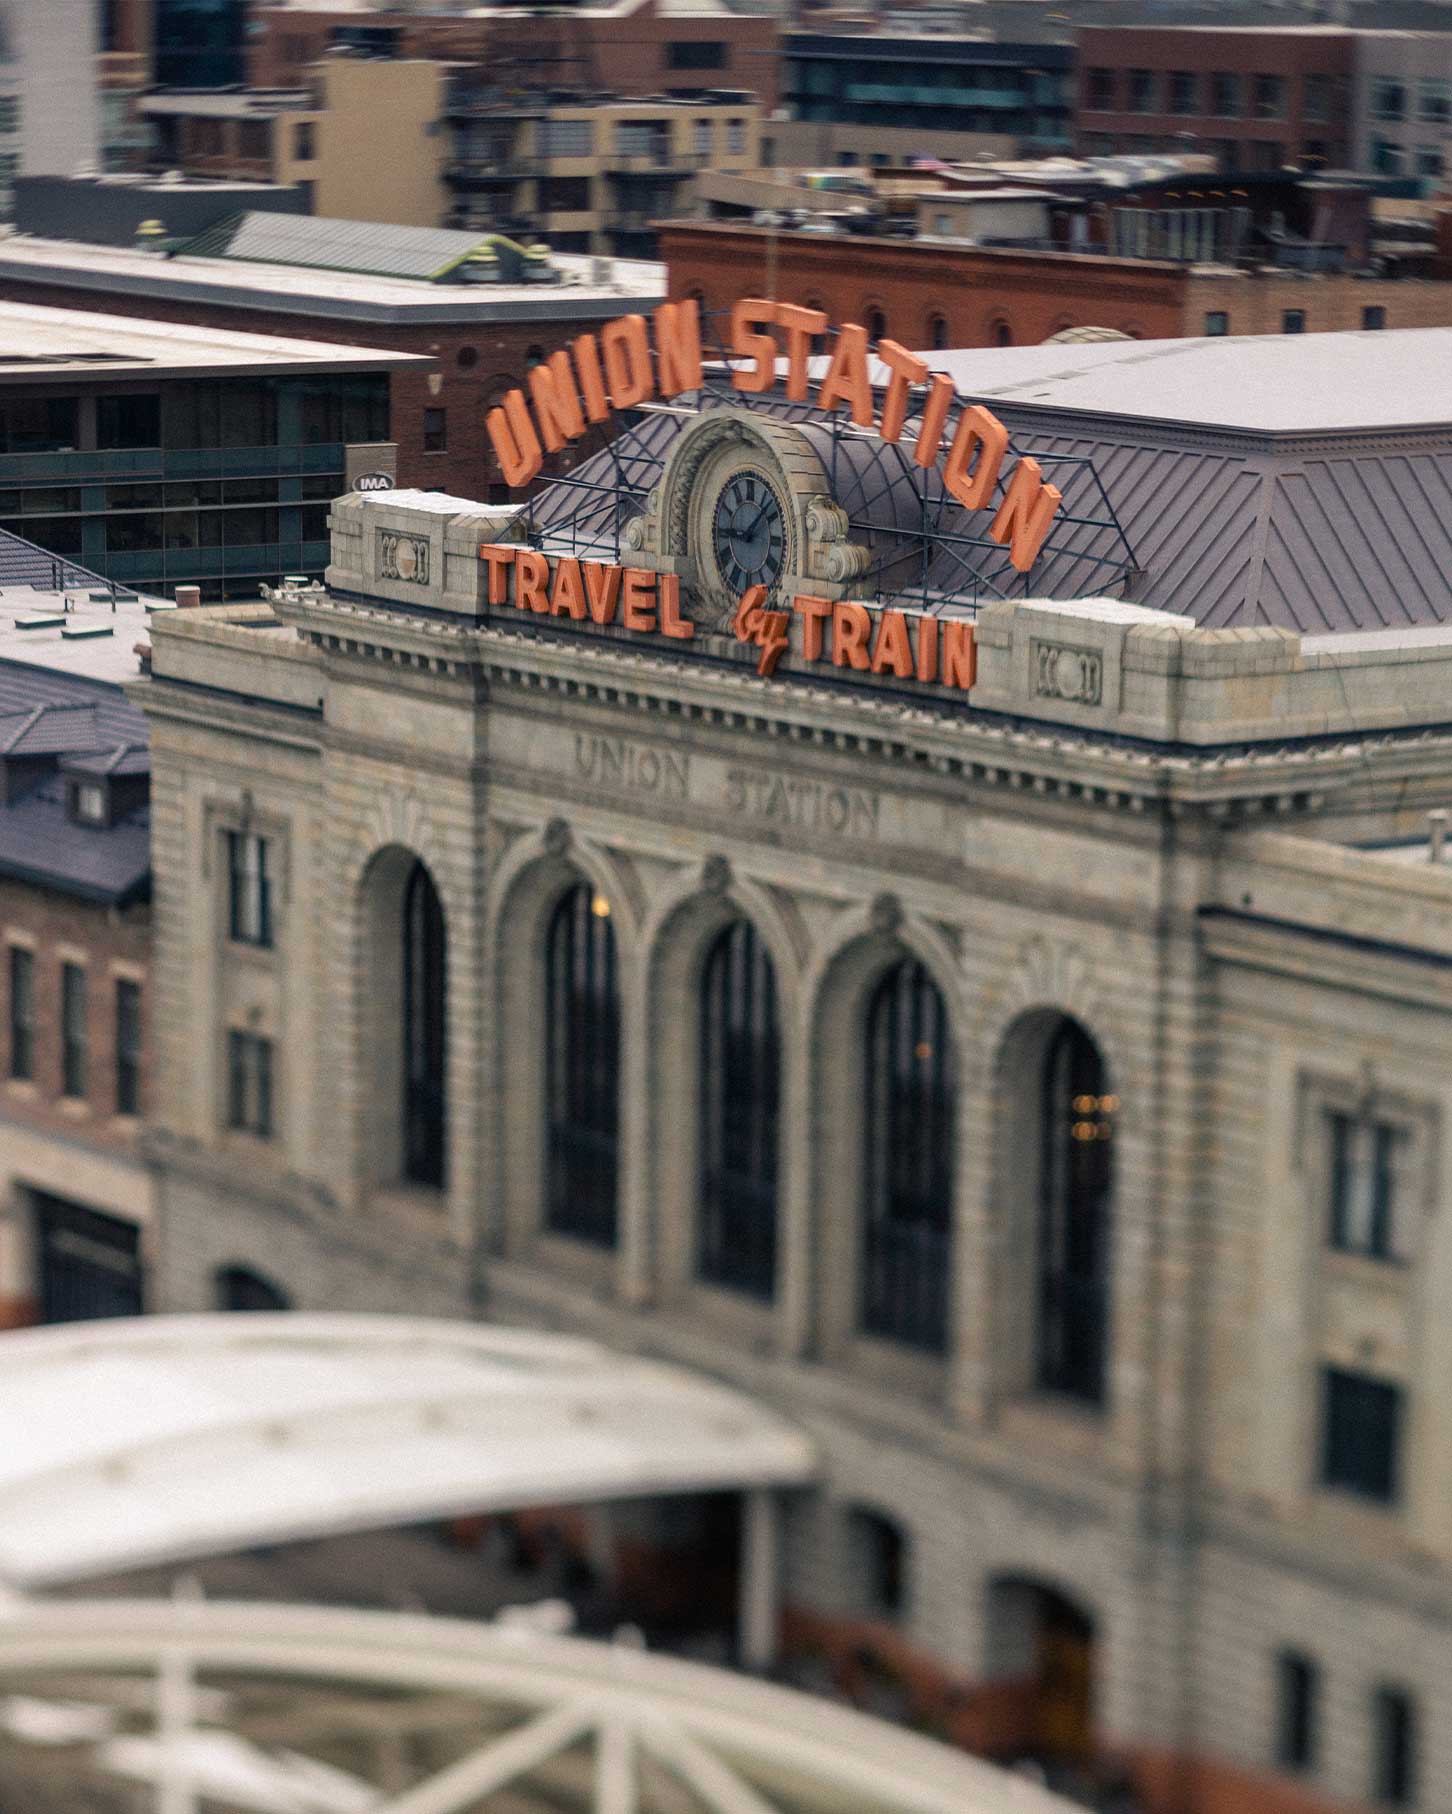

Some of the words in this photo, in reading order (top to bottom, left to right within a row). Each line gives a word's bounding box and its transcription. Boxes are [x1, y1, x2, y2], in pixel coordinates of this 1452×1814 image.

[360, 477, 389, 490] IMA
[486, 299, 703, 486] UNION
[730, 299, 1061, 572] STATION
[480, 544, 694, 639] TRAVEL
[732, 585, 789, 675] by
[794, 595, 977, 689] TRAIN
[575, 732, 690, 799] UNION
[725, 768, 880, 842] STATION
